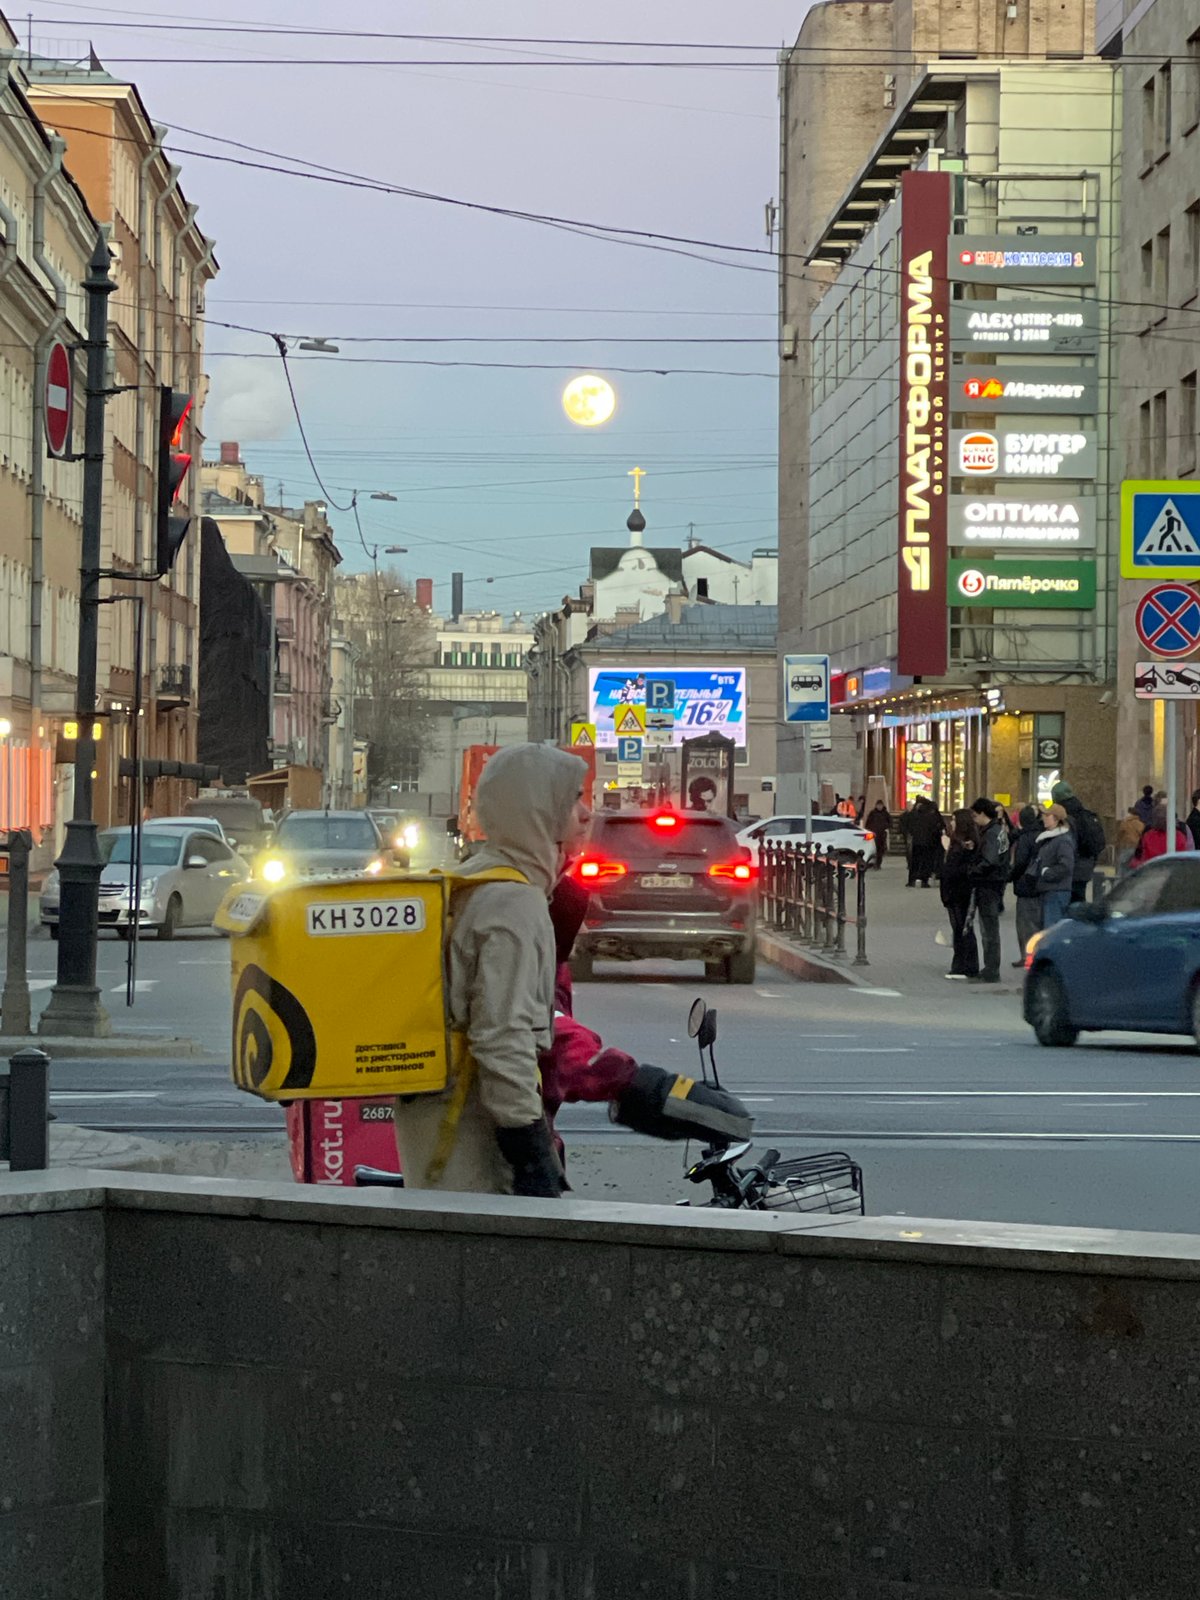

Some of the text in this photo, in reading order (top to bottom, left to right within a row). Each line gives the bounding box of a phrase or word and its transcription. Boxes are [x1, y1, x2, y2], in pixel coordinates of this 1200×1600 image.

[967, 312, 1013, 329] ALEX
[905, 249, 934, 543] ПЛАТФОРМА
[1003, 382, 1085, 399] Маркет
[933, 312, 945, 496] ОБУВНОЙ ЦЕНТР
[1005, 433, 1087, 454] БУРГЕР
[963, 455, 995, 463] KING
[1005, 454, 1064, 474] КИНГ
[965, 502, 1080, 523] ОПТИКА
[986, 575, 1079, 594] Пятёрочка
[717, 675, 735, 685] ВТБ
[686, 701, 730, 726] 16%
[370, 1050, 436, 1064] ресторанов
[365, 1062, 424, 1073] магазинов
